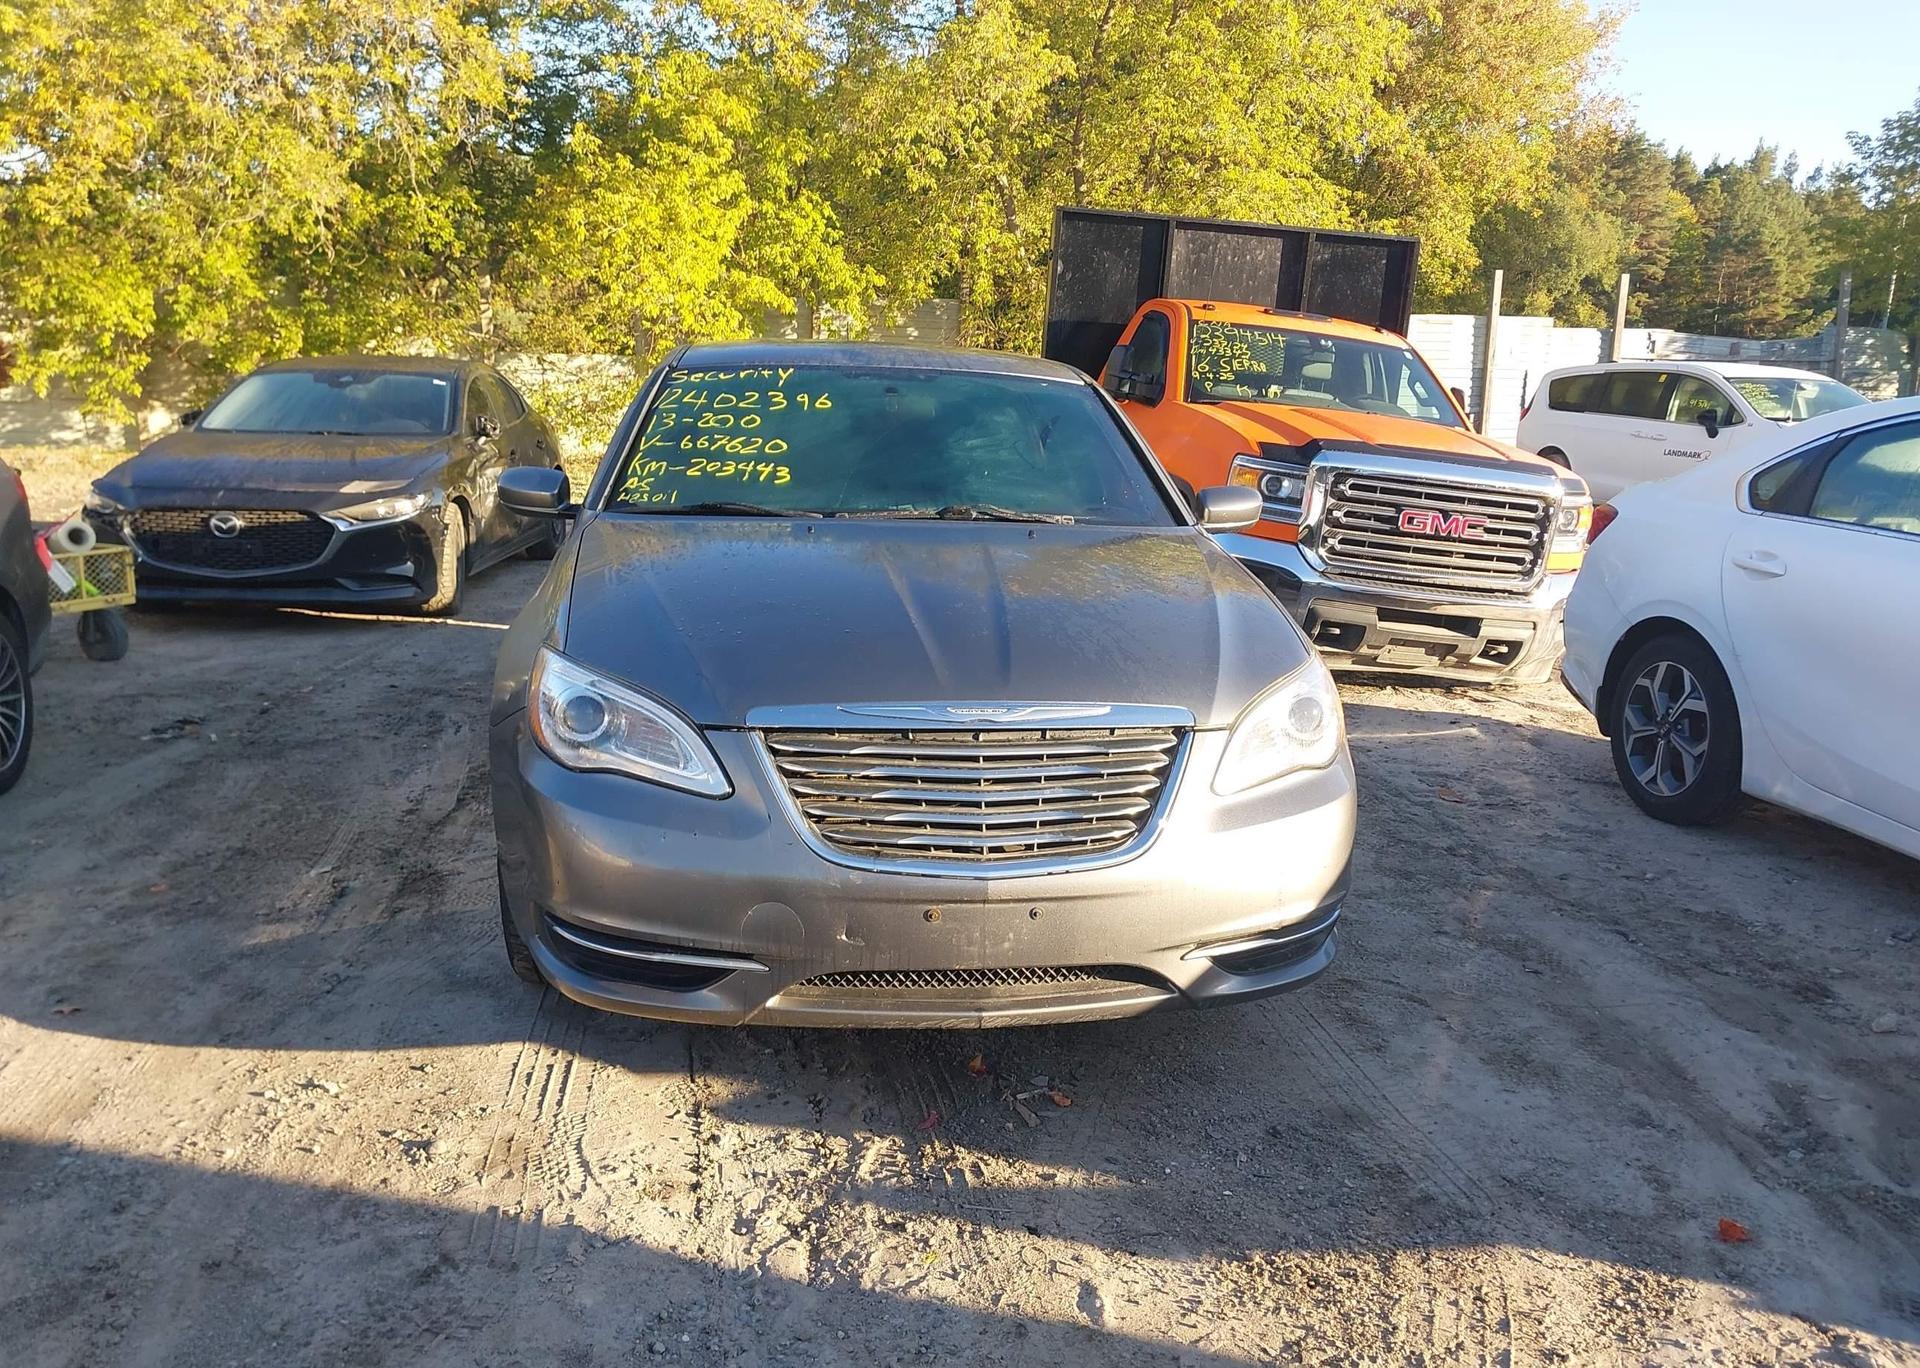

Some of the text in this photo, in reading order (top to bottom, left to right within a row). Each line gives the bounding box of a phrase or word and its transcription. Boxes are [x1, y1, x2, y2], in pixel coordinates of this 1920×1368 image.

[652, 387, 832, 411] 12402396
[646, 412, 761, 433] 13-200
[640, 434, 788, 454] V-667620
[1663, 448, 1702, 460] LANDMARK
[1400, 509, 1489, 539] GMC
